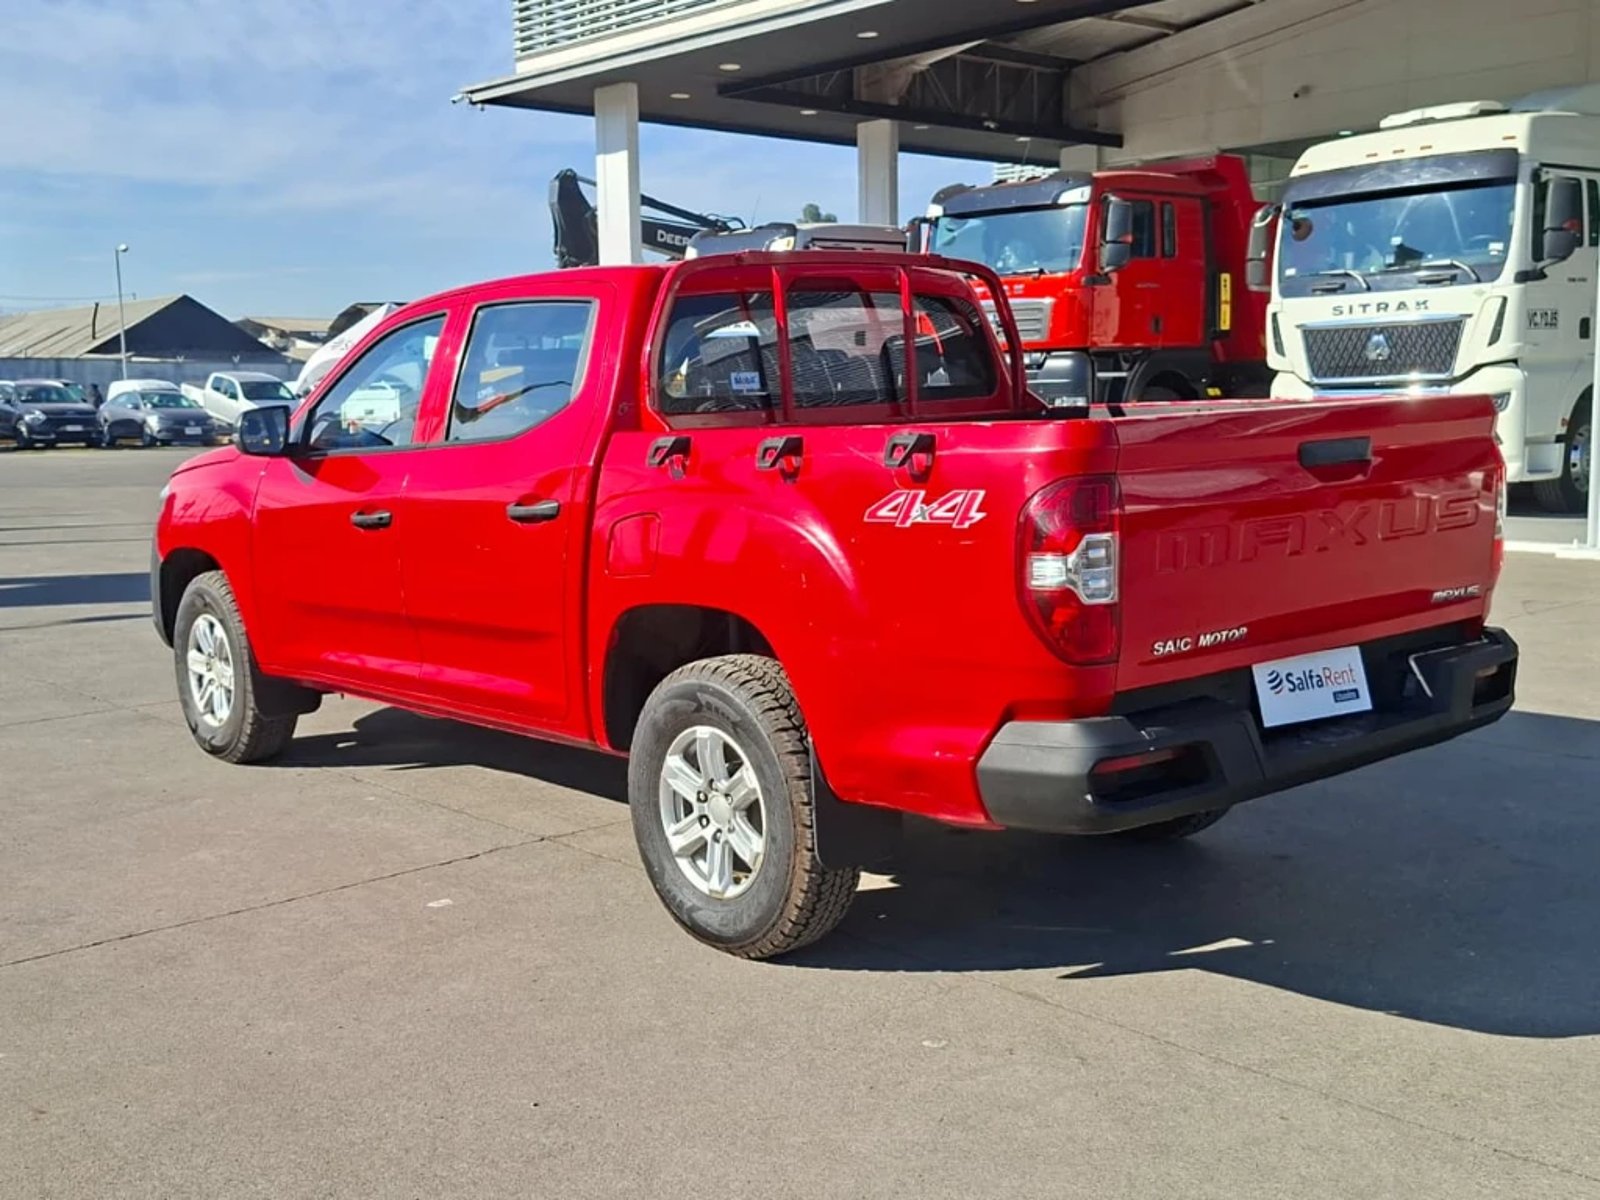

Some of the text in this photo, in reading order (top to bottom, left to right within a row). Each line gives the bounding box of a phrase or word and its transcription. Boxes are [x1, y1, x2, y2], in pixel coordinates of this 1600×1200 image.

[1332, 299, 1429, 316] SITRAK
[863, 489, 988, 529] 4x4
[1155, 491, 1481, 573] MAXUS
[1153, 626, 1248, 656] SAIC MOTOR
[1285, 663, 1356, 693] SalfaRent
